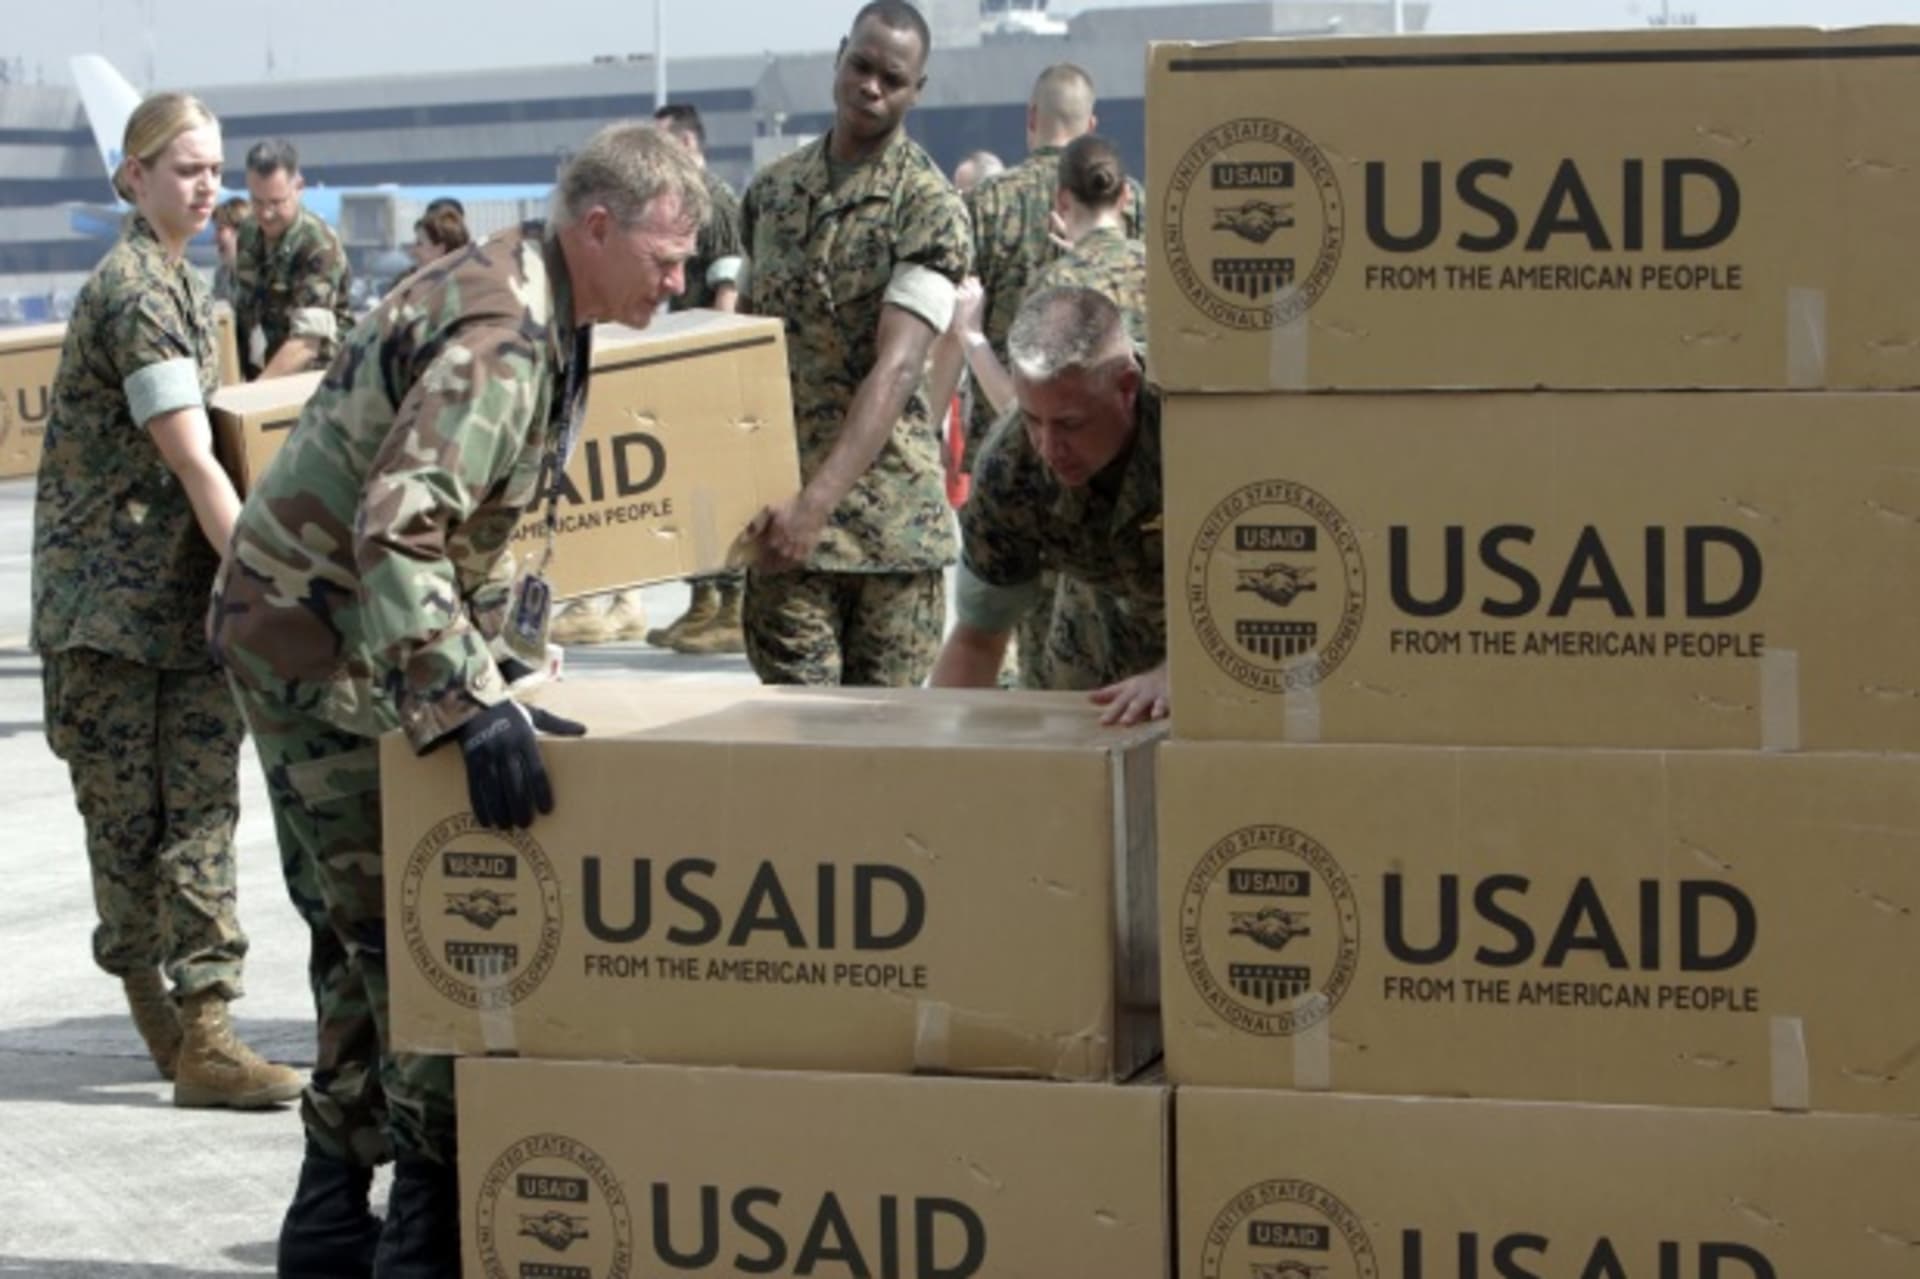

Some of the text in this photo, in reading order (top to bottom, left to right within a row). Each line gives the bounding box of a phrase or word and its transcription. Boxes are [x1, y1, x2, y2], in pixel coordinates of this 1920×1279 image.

[1218, 166, 1285, 186] USAID
[1366, 158, 1740, 253] USAID
[1366, 265, 1742, 290] FROM THE AMERICAN PEOPLE
[523, 431, 668, 514] AID
[604, 498, 673, 526] PEOPLE
[1242, 530, 1305, 549] USAID
[1390, 525, 1762, 619] USAID
[1391, 629, 1765, 658] FROM THE AMERICAN PEOPLE
[1236, 873, 1300, 892] USAID
[582, 857, 926, 951] USAID
[1384, 873, 1757, 971] USAID
[585, 955, 927, 989] FROM THE AMERICAN PEOPLE
[1384, 976, 1759, 1012] FROM THE AMERICAN PEOPLE
[522, 1179, 580, 1199] USAID
[652, 1183, 987, 1279] USAID
[1255, 1225, 1321, 1246] USAID
